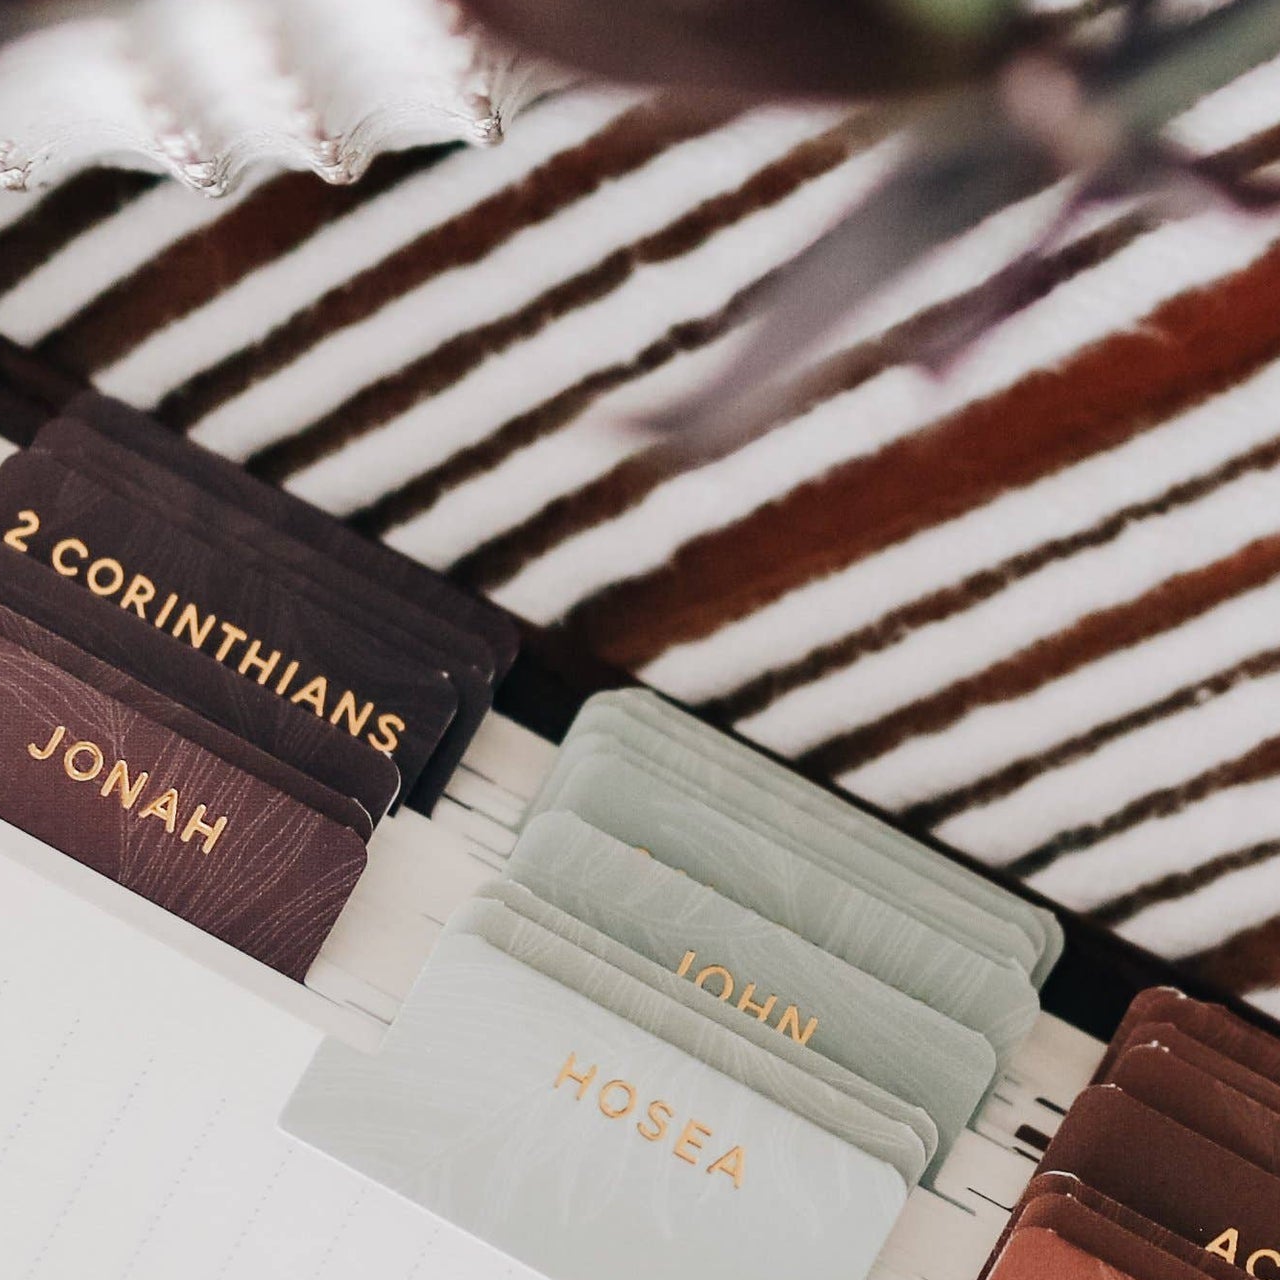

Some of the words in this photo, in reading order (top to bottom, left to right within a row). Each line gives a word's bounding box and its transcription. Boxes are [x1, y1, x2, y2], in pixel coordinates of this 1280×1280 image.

[3, 508, 39, 556] 2
[51, 536, 409, 754] CORINTHIANS
[27, 723, 230, 855] JONAH
[676, 949, 820, 1048] JOHN
[553, 1050, 749, 1191] HOSEA
